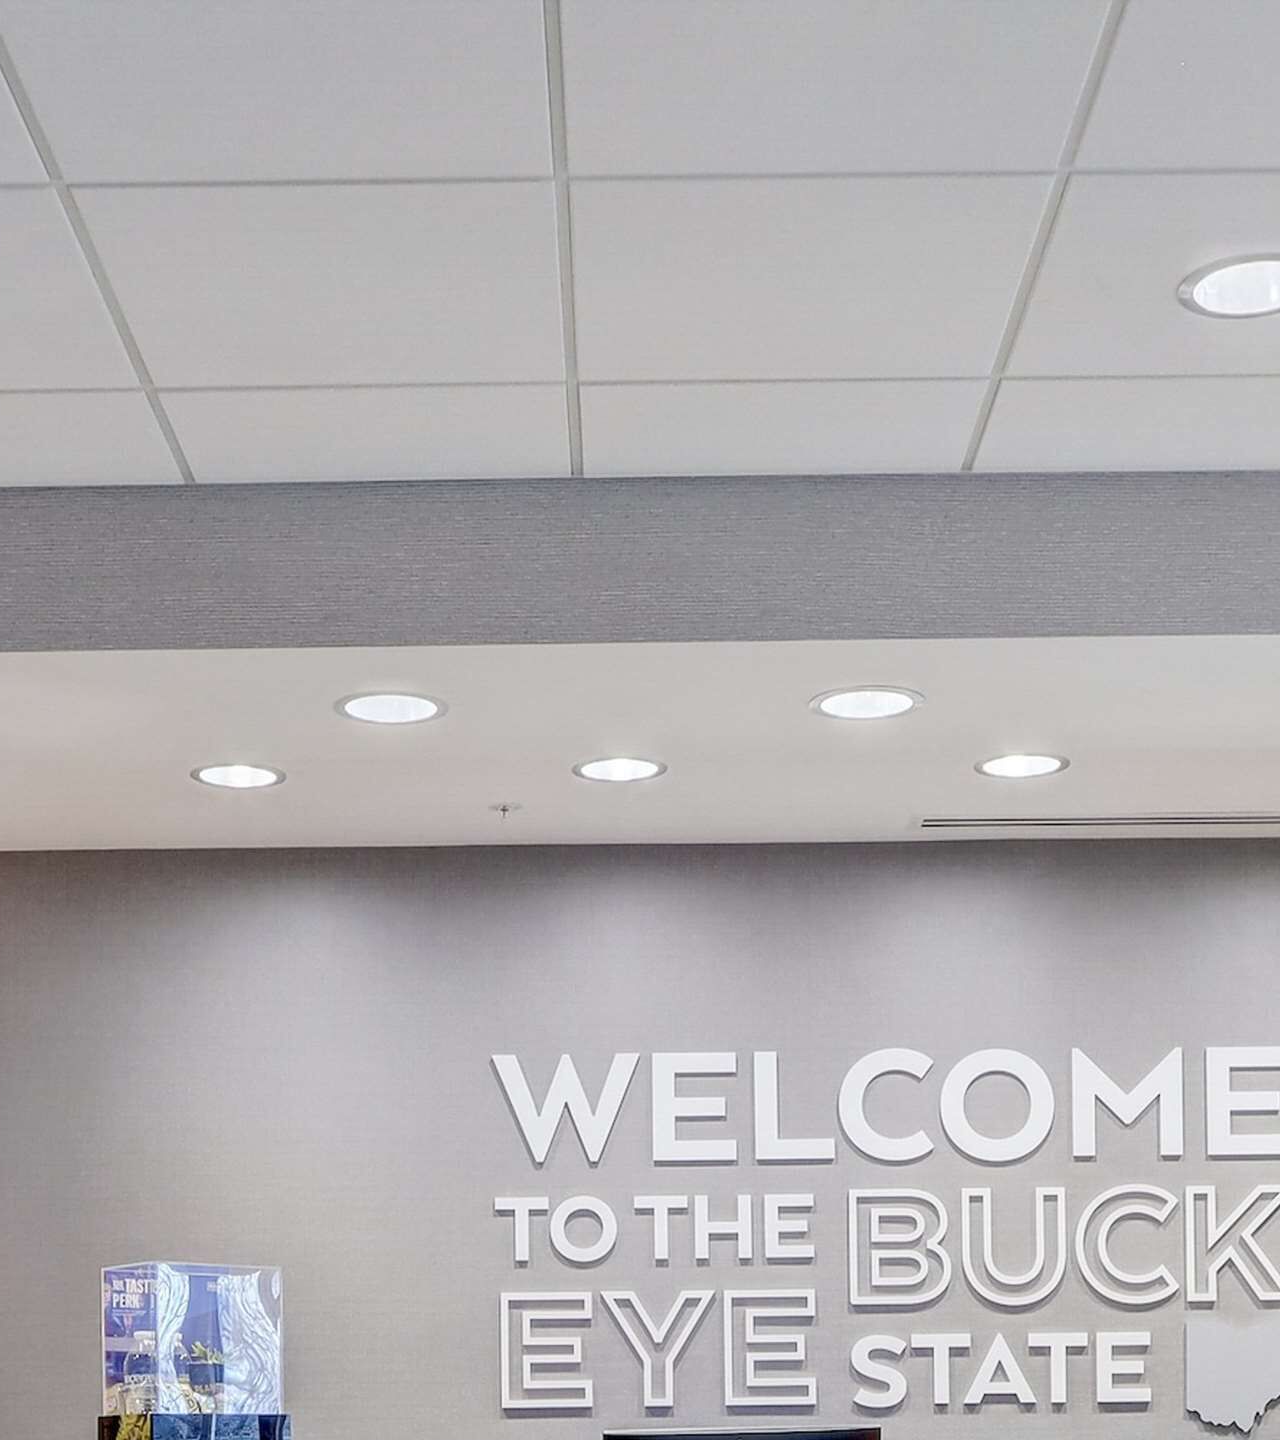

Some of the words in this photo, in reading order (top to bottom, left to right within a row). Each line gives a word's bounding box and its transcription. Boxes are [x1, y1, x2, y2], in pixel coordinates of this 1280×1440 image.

[494, 1196, 617, 1263] TO
[634, 1194, 815, 1262] THE
[500, 1289, 817, 1409] EYE
[850, 1331, 1153, 1410] STATE
